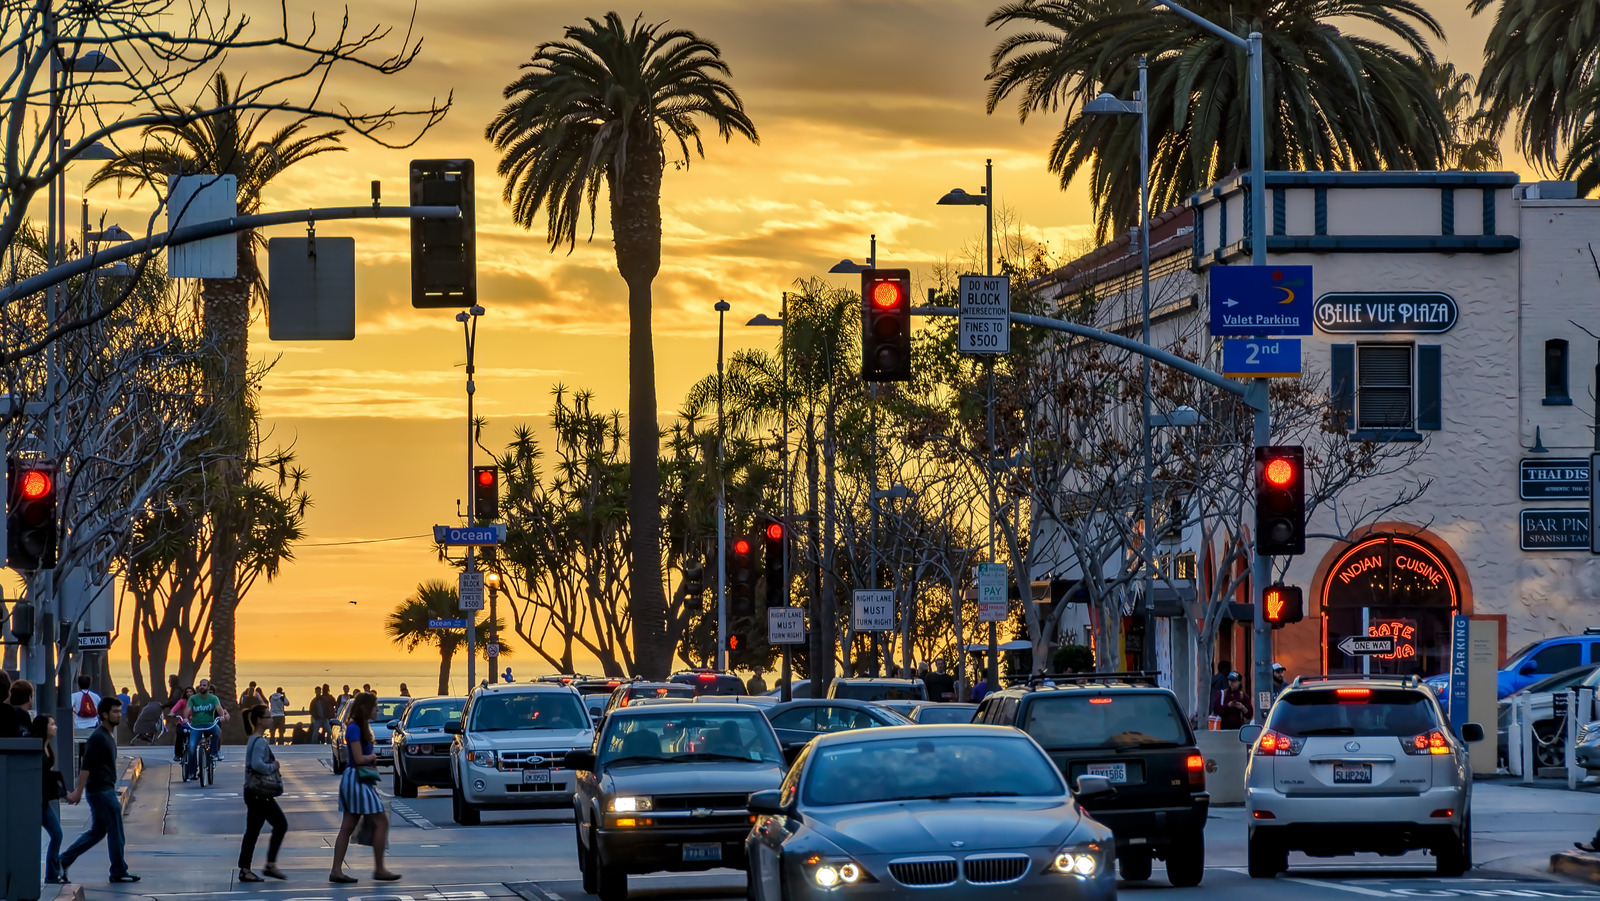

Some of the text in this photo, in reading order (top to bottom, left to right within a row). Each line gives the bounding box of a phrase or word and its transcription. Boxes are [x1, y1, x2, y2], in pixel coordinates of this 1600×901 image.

[969, 280, 1000, 290] DO NOT
[968, 292, 1000, 305] BLOCK
[962, 307, 1006, 316] INTERSECTION
[1318, 303, 1449, 326] BELLE VUE PLAZA
[1222, 314, 1300, 326] Valet Parking
[965, 322, 1003, 332] FINES TO
[970, 334, 998, 347] $500
[1245, 342, 1279, 364] 2nd
[1528, 469, 1589, 480] THAI DIS
[1526, 518, 1557, 531] BAR
[450, 530, 492, 541] Ocean
[1529, 534, 1568, 542] SPANISH
[1339, 555, 1444, 586] INDIAN CUISINE
[984, 587, 1002, 596] PAY
[1354, 641, 1389, 650] ONE WAY
[1454, 620, 1466, 676] PARKING
[1336, 771, 1369, 780] 5LHP294
